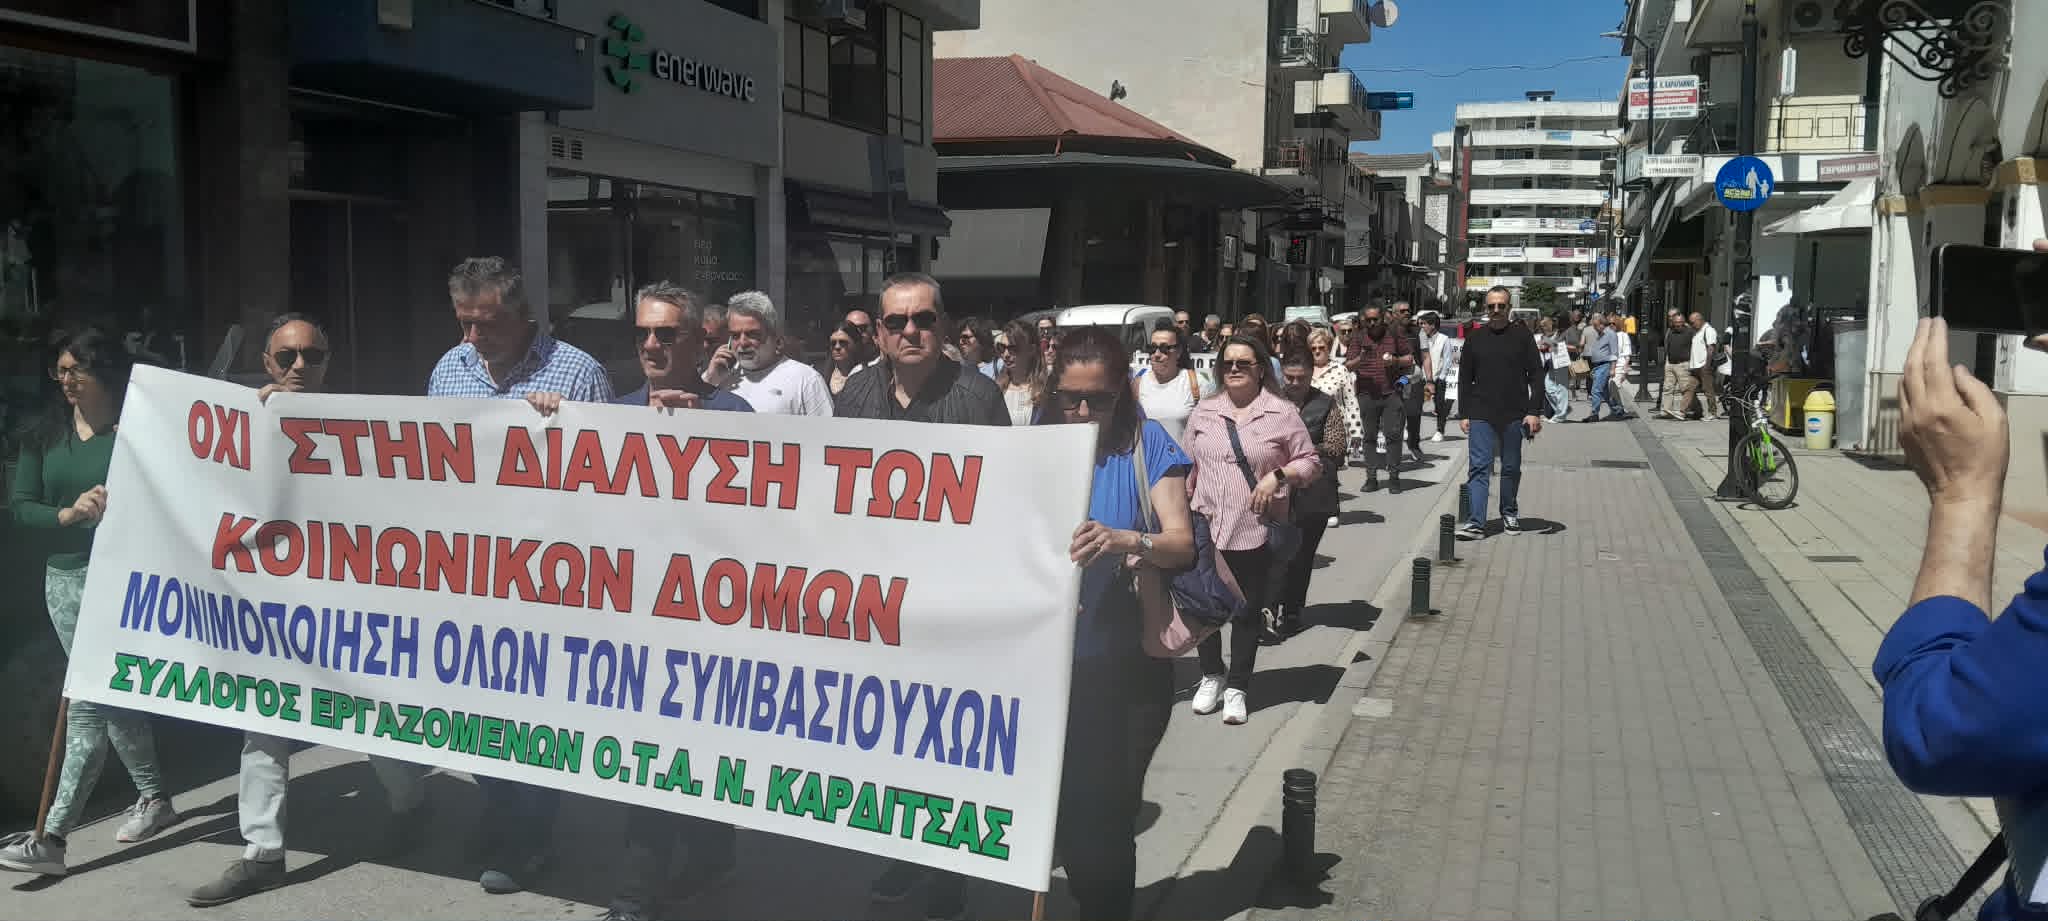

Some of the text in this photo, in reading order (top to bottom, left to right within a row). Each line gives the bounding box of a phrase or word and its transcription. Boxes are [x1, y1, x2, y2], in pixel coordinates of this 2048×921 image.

[655, 49, 755, 102] enerwave
[189, 401, 983, 525] ΟΧΙ ΣΤΗΝ ΔΙΑΛΥΣΗ ΤΩΝ
[212, 512, 907, 646] ΚΟΙΝΩΝΙΚΩΝ ΔΟΜΩΝ
[119, 571, 1020, 776] ΜΟΝΙΜΟΠΟΙΗΣΗ ΟΛΩΝ ΤΩΝ ΣΥΜΒΑΣΙΟΥΧΩΝ
[109, 653, 1013, 861] ΣΥΛΛΟΓΟΣ ΕΡΓΑΖΟΜΕΝΩΝ Ο.Τ.Α. Ν. ΚΑΡΔΙΤΣΑΣ
